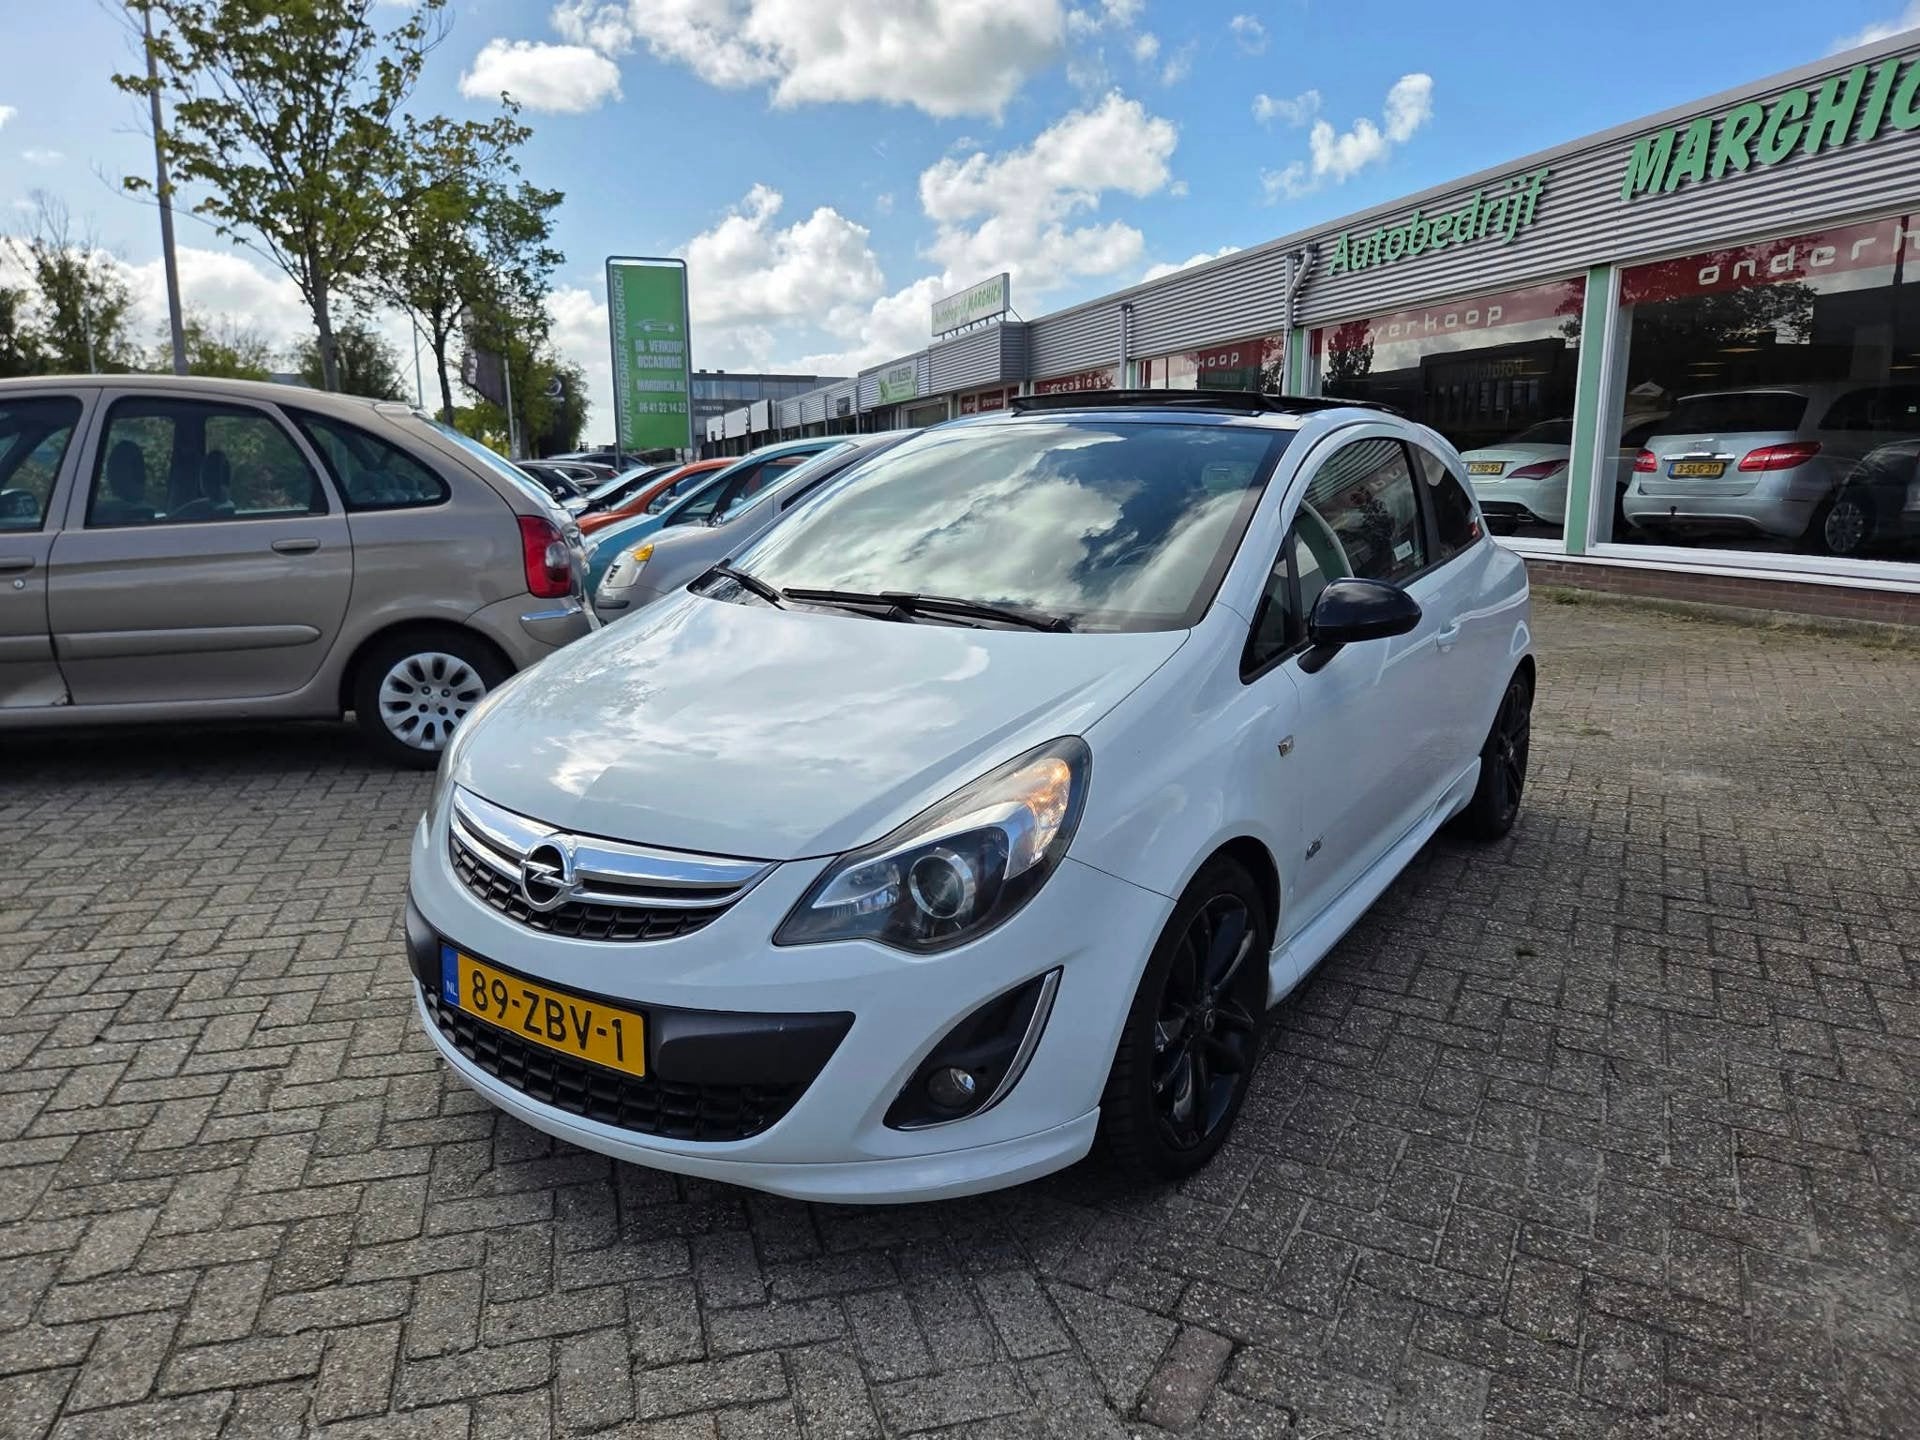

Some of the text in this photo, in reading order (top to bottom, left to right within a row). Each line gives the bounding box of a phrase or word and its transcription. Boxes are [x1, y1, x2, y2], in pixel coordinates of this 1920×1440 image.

[1327, 169, 1549, 276] Autobedrijf
[1369, 305, 1504, 339] verkoop
[446, 980, 458, 997] NL
[471, 968, 624, 1062] 89-ZBV-1
